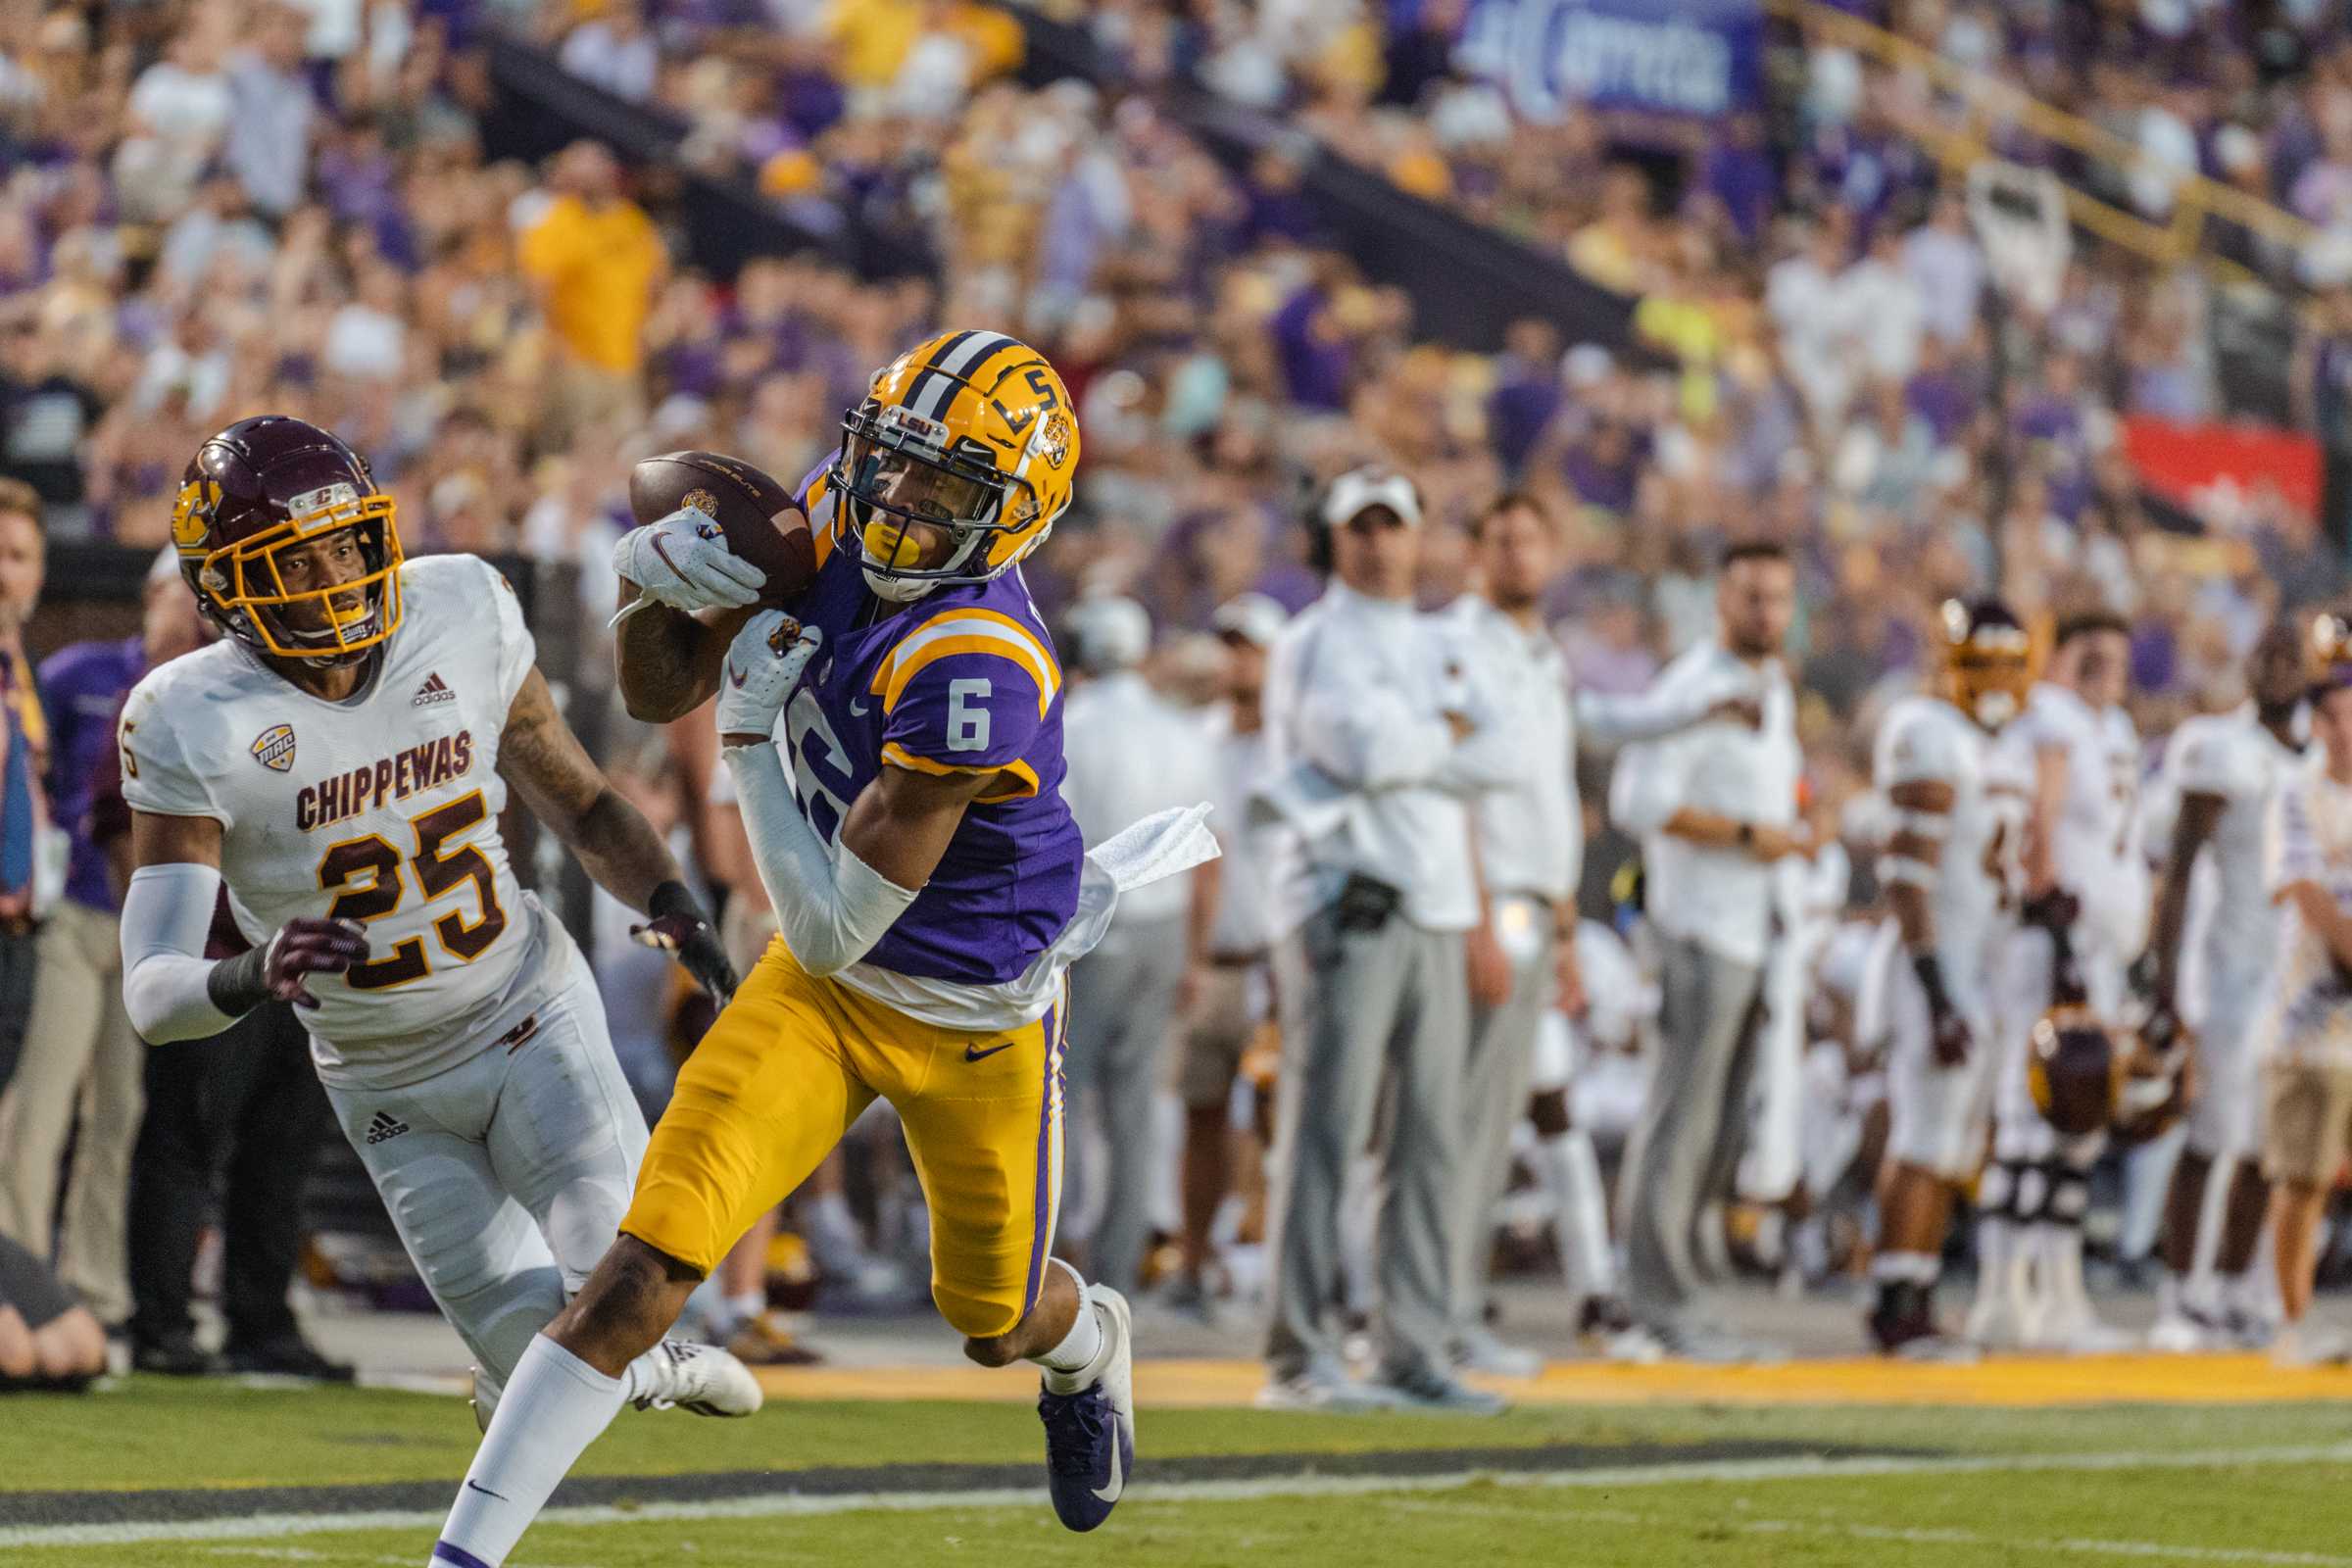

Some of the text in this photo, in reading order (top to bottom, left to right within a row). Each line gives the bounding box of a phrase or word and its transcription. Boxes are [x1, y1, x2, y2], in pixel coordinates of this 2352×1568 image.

[898, 412, 932, 436] LSU
[991, 369, 1074, 436] LS
[315, 488, 332, 506] C
[415, 690, 456, 707] adidas
[947, 678, 993, 752] 6
[256, 731, 295, 765] MAC
[297, 730, 474, 831] CHIPPEWAS
[787, 686, 855, 863] 6
[316, 788, 509, 991] 25
[367, 1122, 410, 1145] adidas
